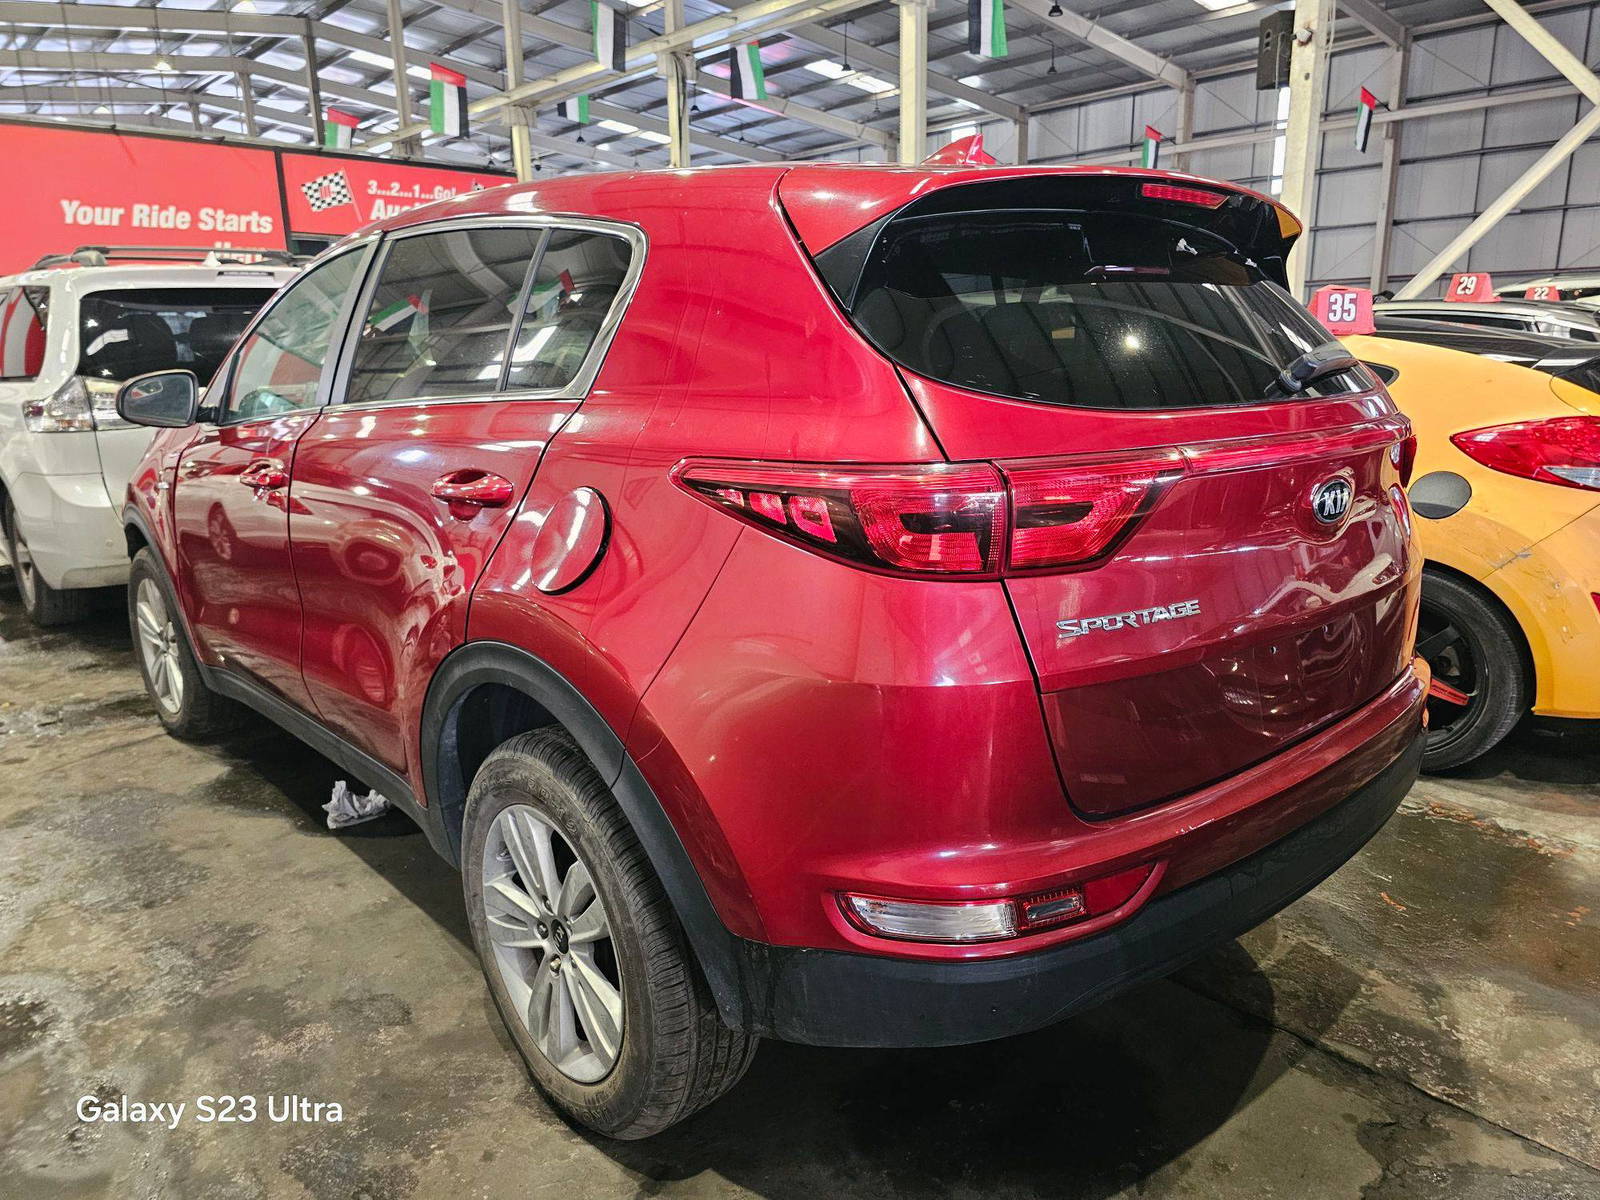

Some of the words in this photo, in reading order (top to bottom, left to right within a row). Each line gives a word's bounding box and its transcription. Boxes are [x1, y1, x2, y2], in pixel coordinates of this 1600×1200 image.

[60, 199, 125, 227] Your
[131, 203, 192, 230] Ride
[197, 207, 273, 234] Starts
[1456, 276, 1477, 295] 29
[1534, 286, 1550, 300] 22
[1328, 293, 1356, 322] 35
[1323, 488, 1350, 516] KIA
[1056, 599, 1201, 639] SPORTAGE
